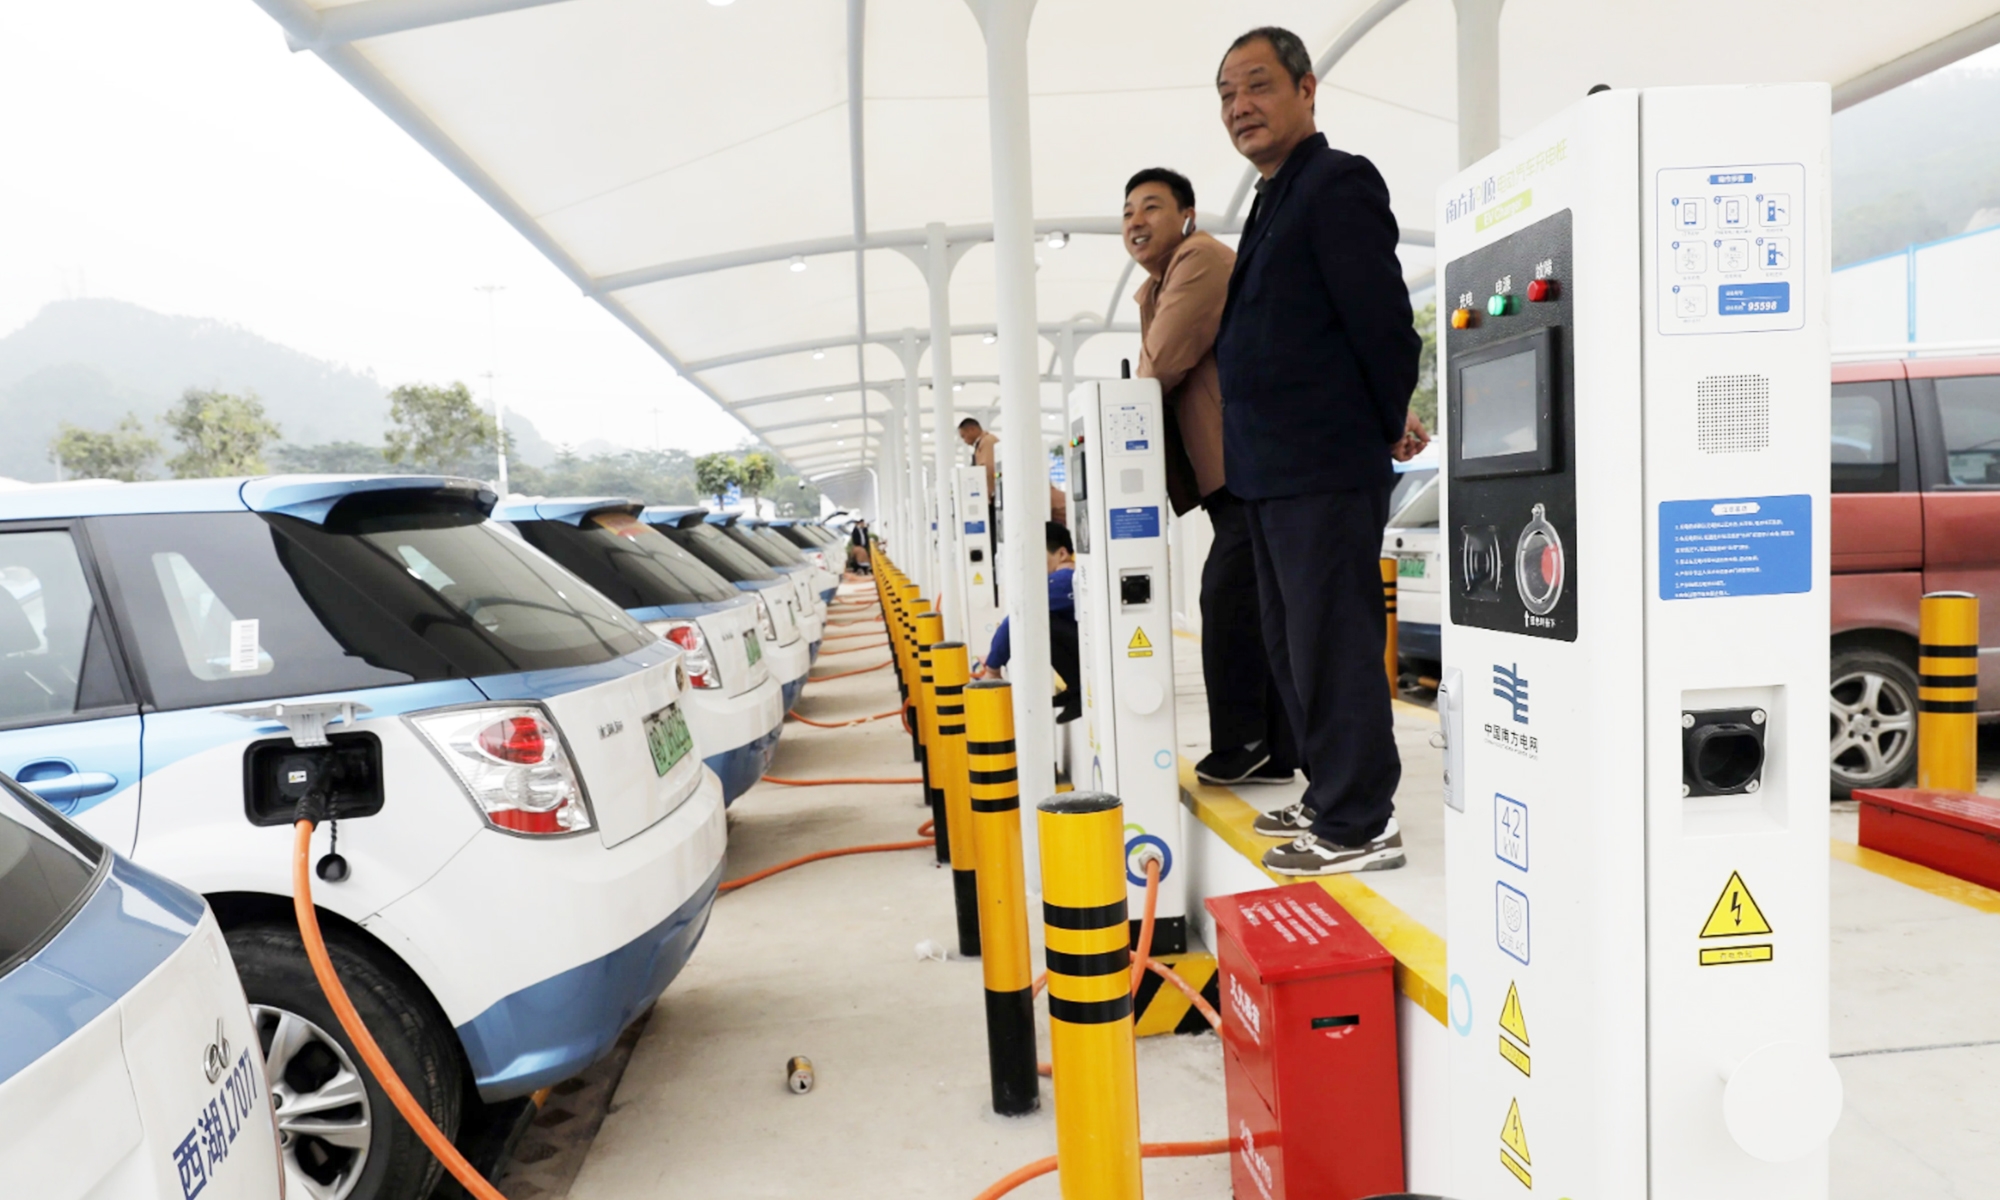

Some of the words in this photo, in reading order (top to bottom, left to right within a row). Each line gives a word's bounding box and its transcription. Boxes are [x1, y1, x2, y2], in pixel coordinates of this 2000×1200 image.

[1495, 274, 1511, 295] 电源
[1459, 291, 1474, 309] 充电
[1747, 301, 1777, 312] 95598
[1484, 723, 1539, 754] 中国南方电网
[1501, 805, 1521, 839] 42
[1503, 835, 1520, 861] kW
